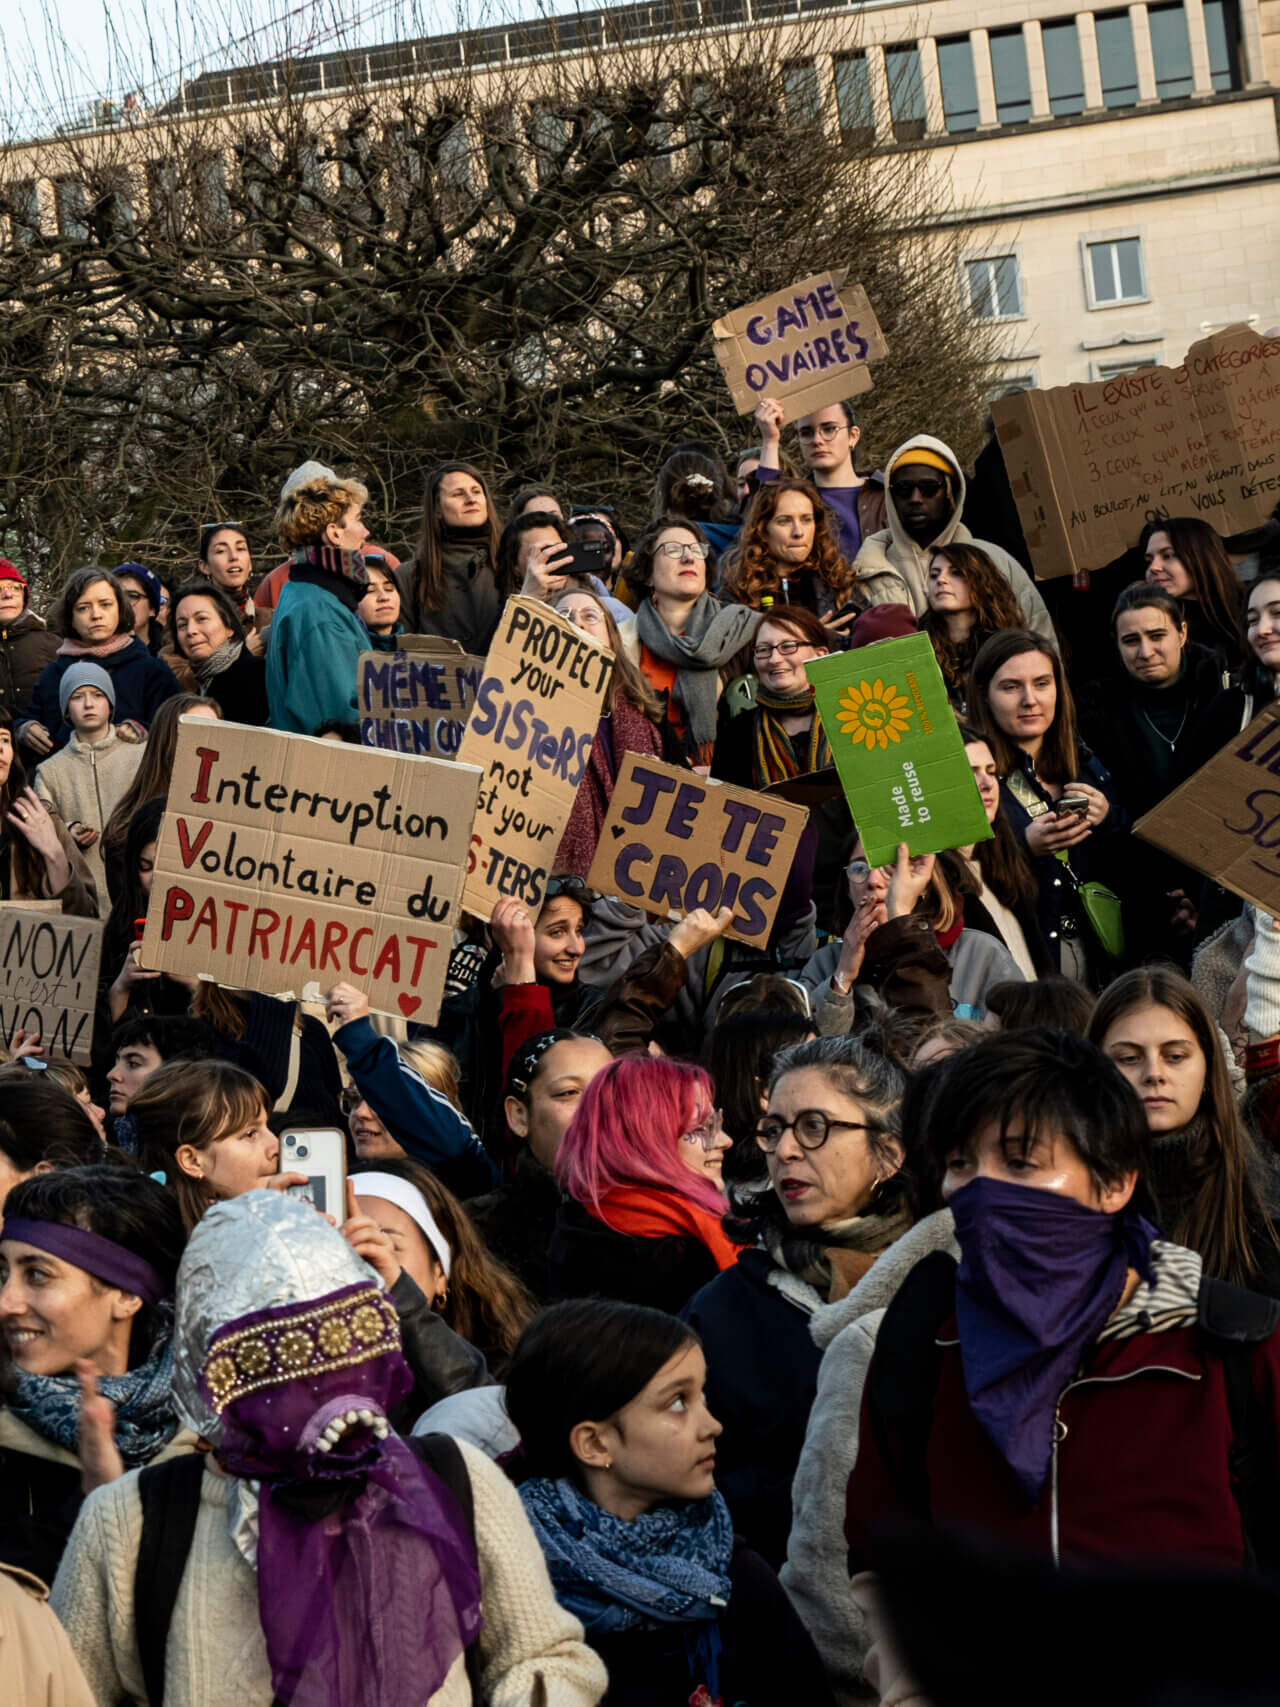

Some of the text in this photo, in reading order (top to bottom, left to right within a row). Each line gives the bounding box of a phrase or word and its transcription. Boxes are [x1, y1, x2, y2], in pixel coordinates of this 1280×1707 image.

[746, 283, 843, 346] GAME
[1174, 364, 1190, 385] 3
[1070, 510, 1088, 528] AU
[1136, 493, 1151, 508] AU
[1143, 503, 1171, 524] ON
[1190, 488, 1227, 511] VOUS
[505, 607, 616, 695] PROTECT
[509, 659, 565, 700] your
[456, 665, 483, 710] M
[191, 746, 449, 845] Interruption
[476, 784, 499, 815] st
[489, 759, 533, 797] not
[891, 785, 914, 828] Made
[902, 760, 932, 824] to reuse
[494, 804, 555, 842] your
[622, 766, 788, 868] JE TE
[176, 817, 452, 923] Volontaire du
[467, 833, 547, 907] S-TERS
[613, 842, 778, 937] CROIS
[3, 920, 93, 979] NON
[161, 886, 438, 987] PATRIARCAT
